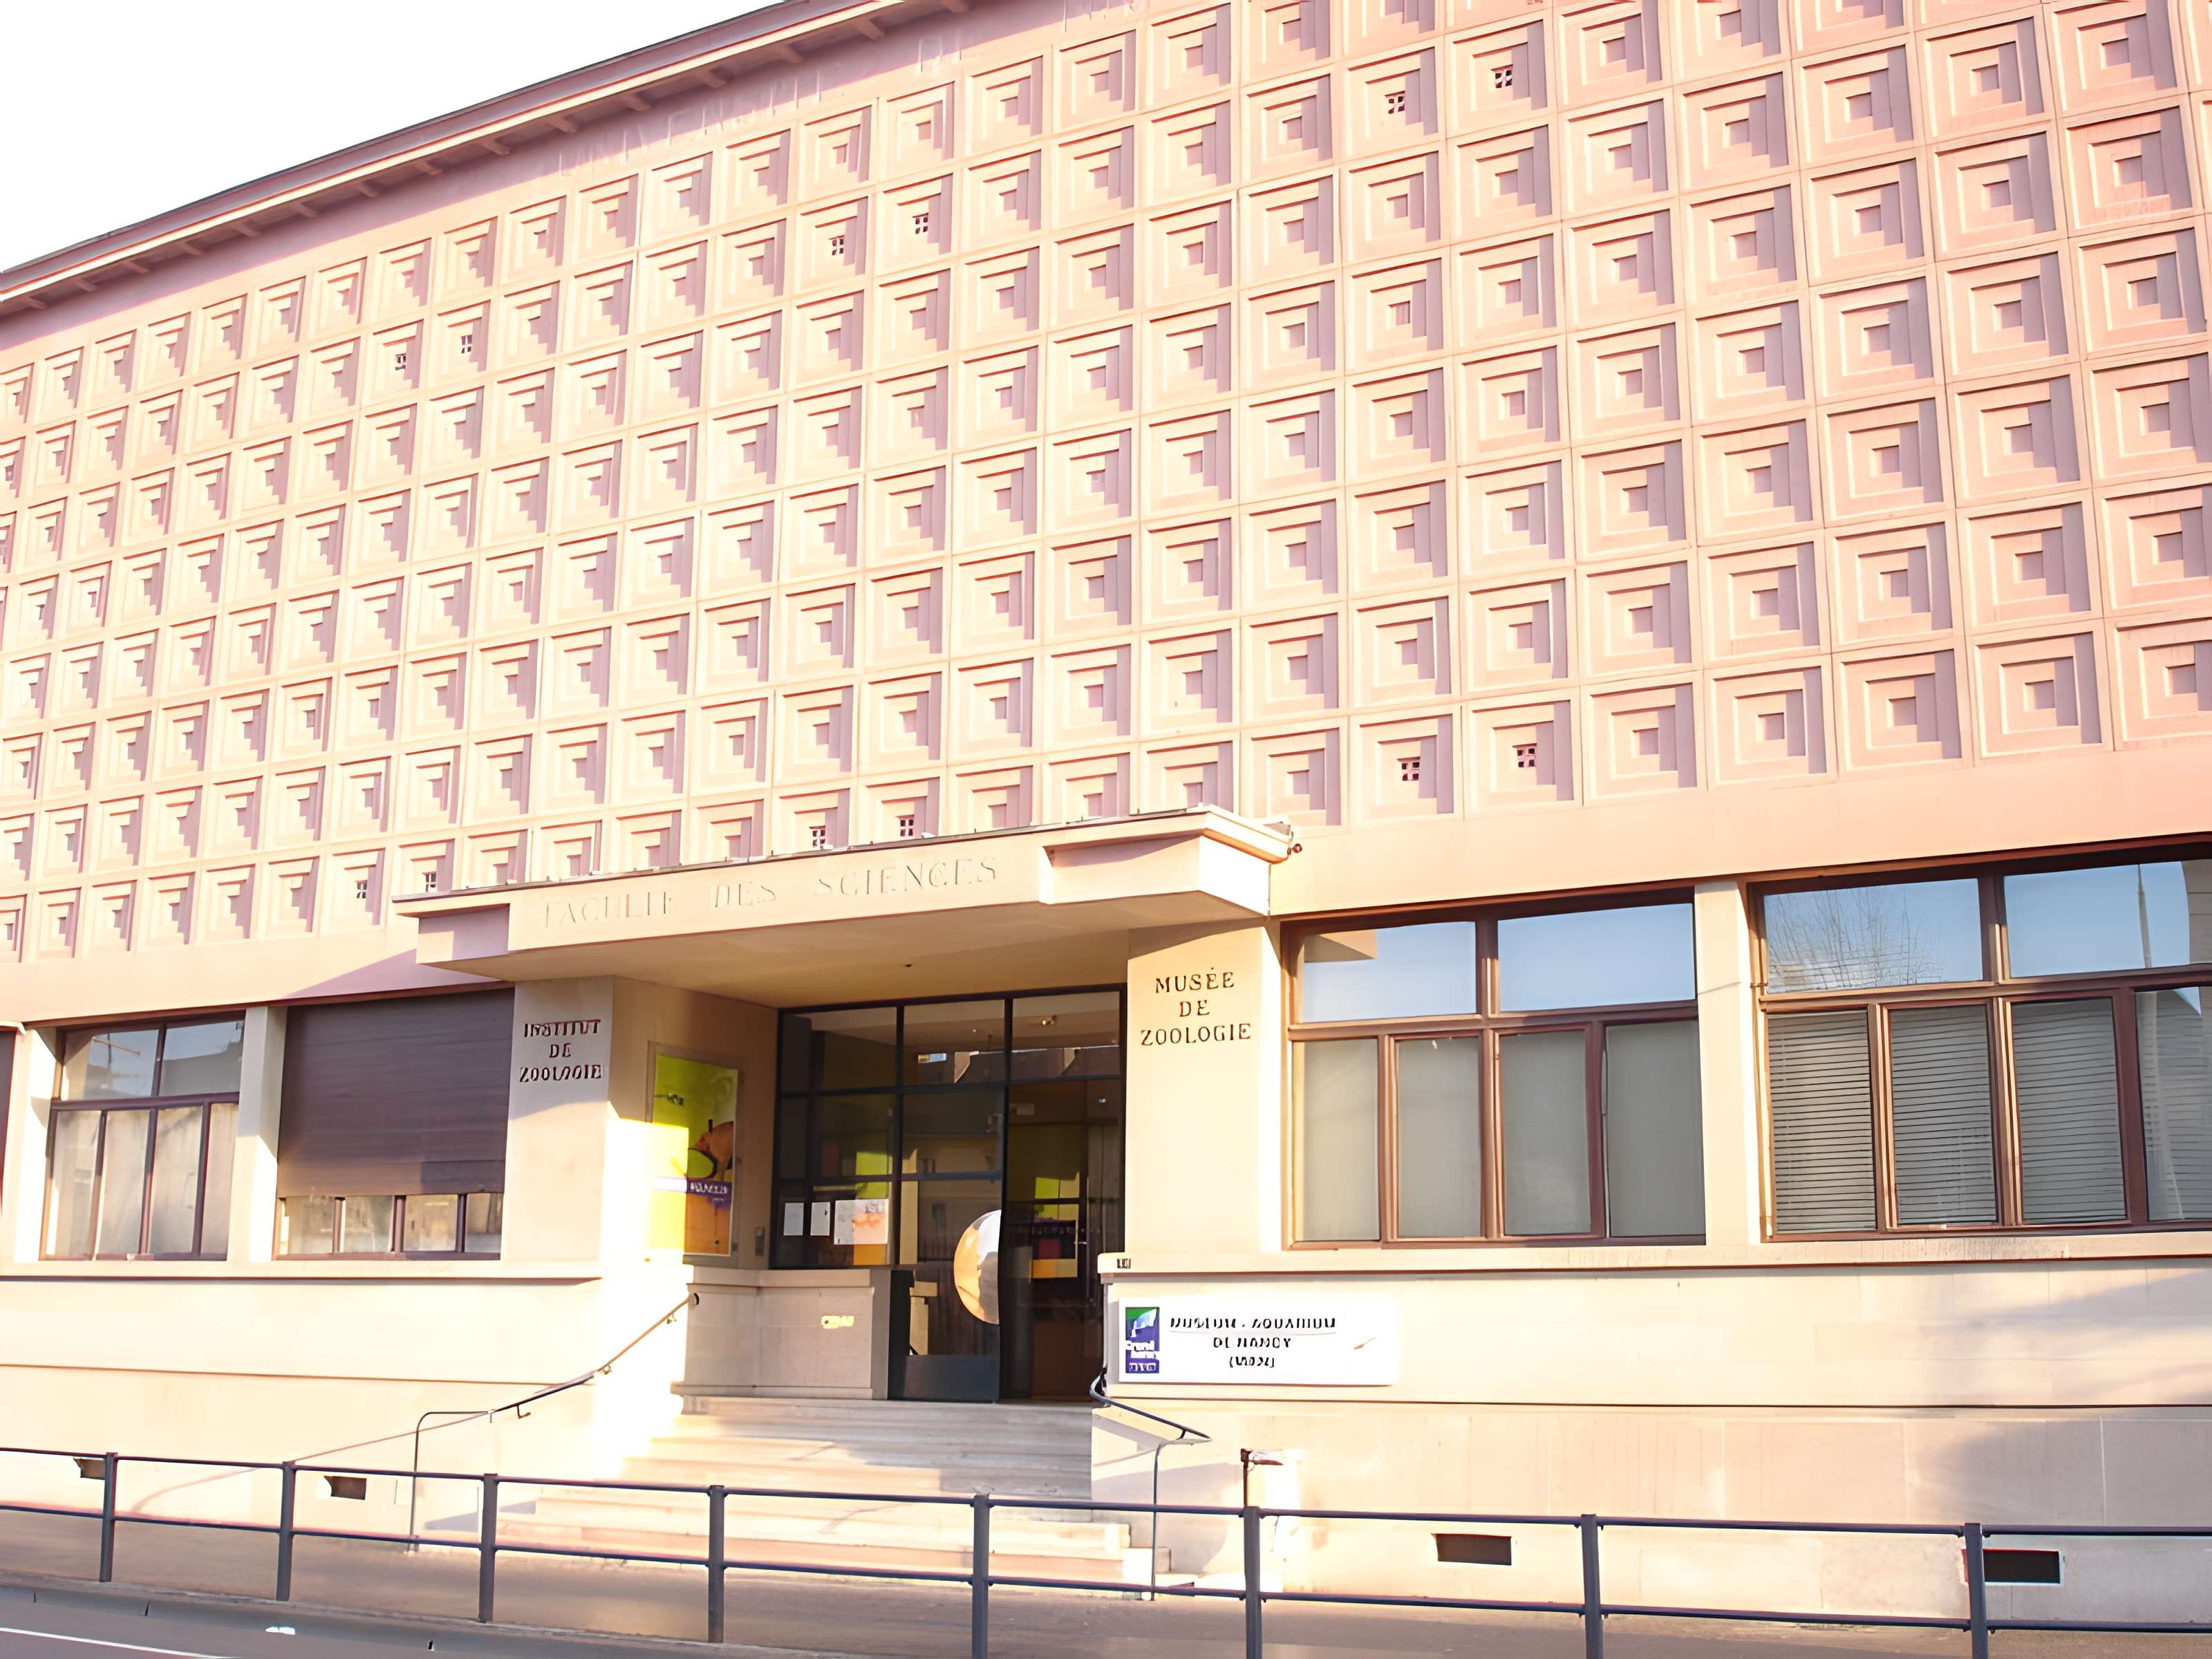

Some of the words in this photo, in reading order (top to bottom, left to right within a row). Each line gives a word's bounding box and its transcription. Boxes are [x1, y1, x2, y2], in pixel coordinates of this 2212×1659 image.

[713, 881, 778, 909] DES
[815, 856, 997, 897] SCIENCES
[1179, 1000, 1210, 1018] DE
[1141, 1023, 1251, 1046] ZOOLOGIE
[548, 1042, 572, 1058] DE
